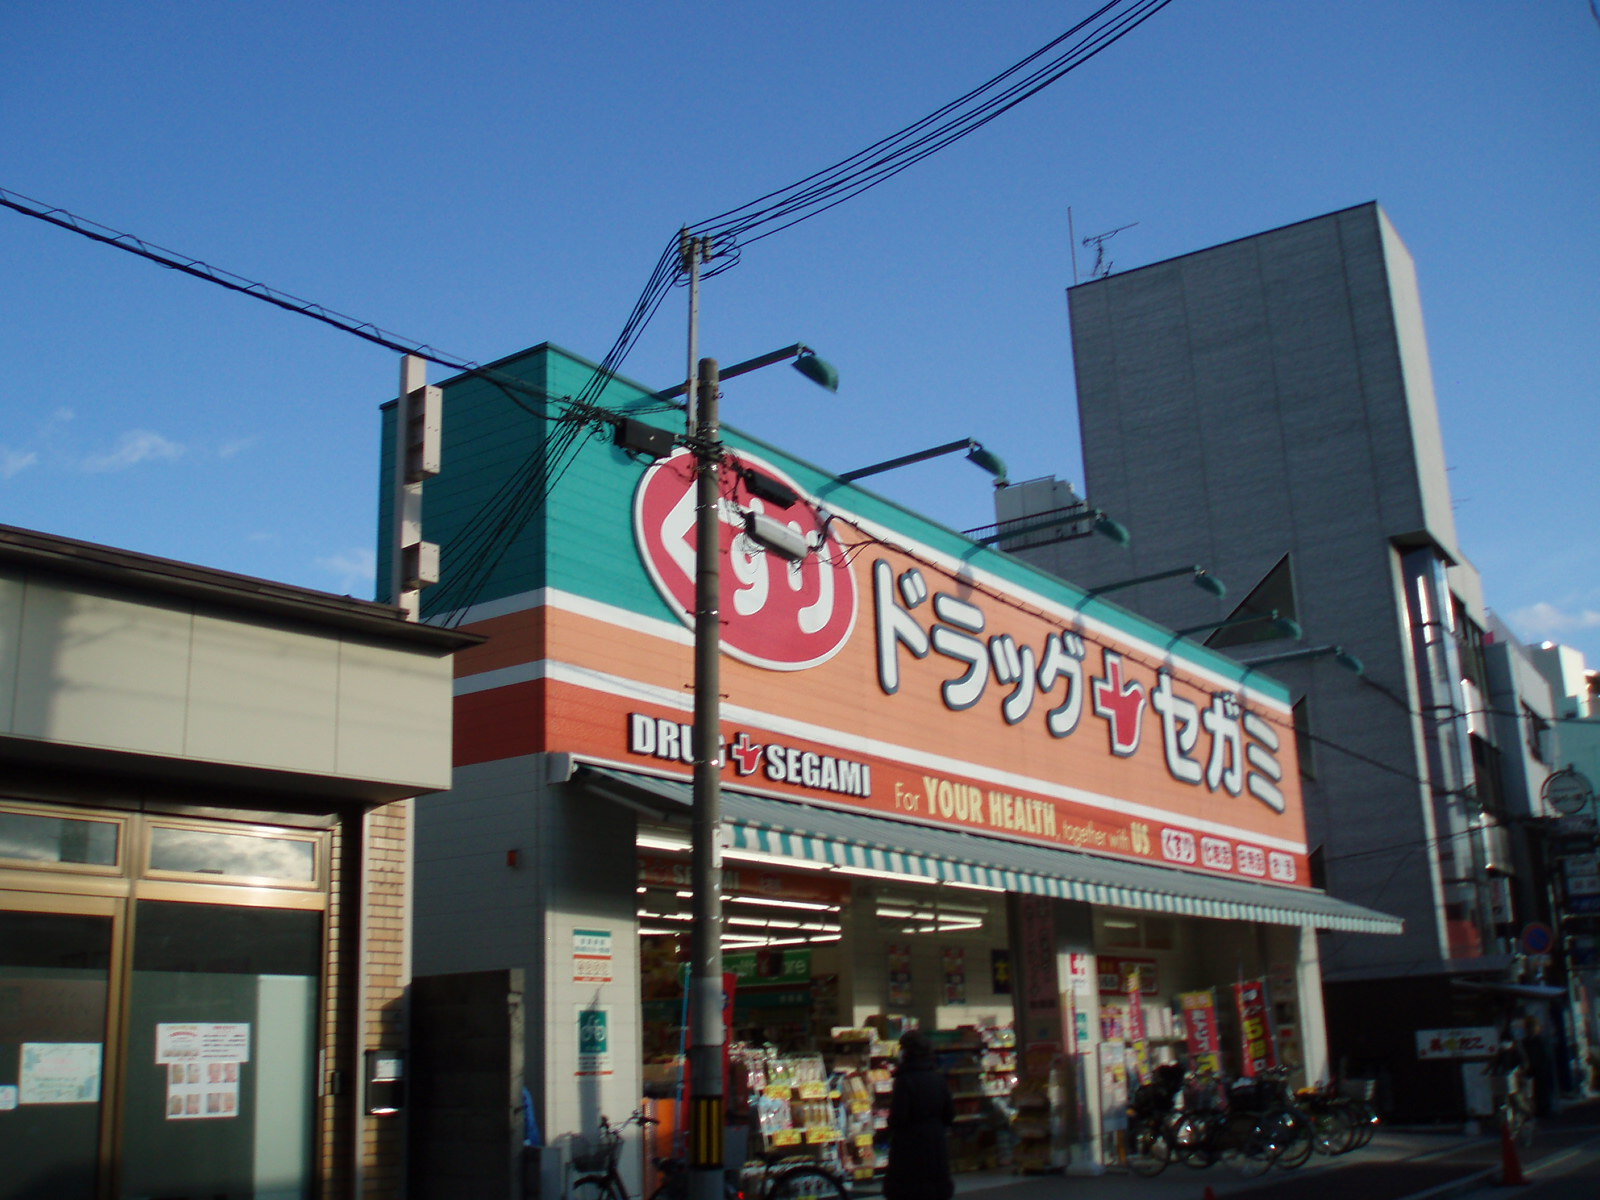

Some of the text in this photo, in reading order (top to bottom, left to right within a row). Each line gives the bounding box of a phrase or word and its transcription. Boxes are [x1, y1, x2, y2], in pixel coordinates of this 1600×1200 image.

[873, 558, 1285, 815] ドラッグ セガミ
[628, 713, 872, 797] DRU SEGAMI
[894, 782, 920, 811] For
[922, 775, 984, 823] YOUR
[1165, 832, 1191, 860] くすり
